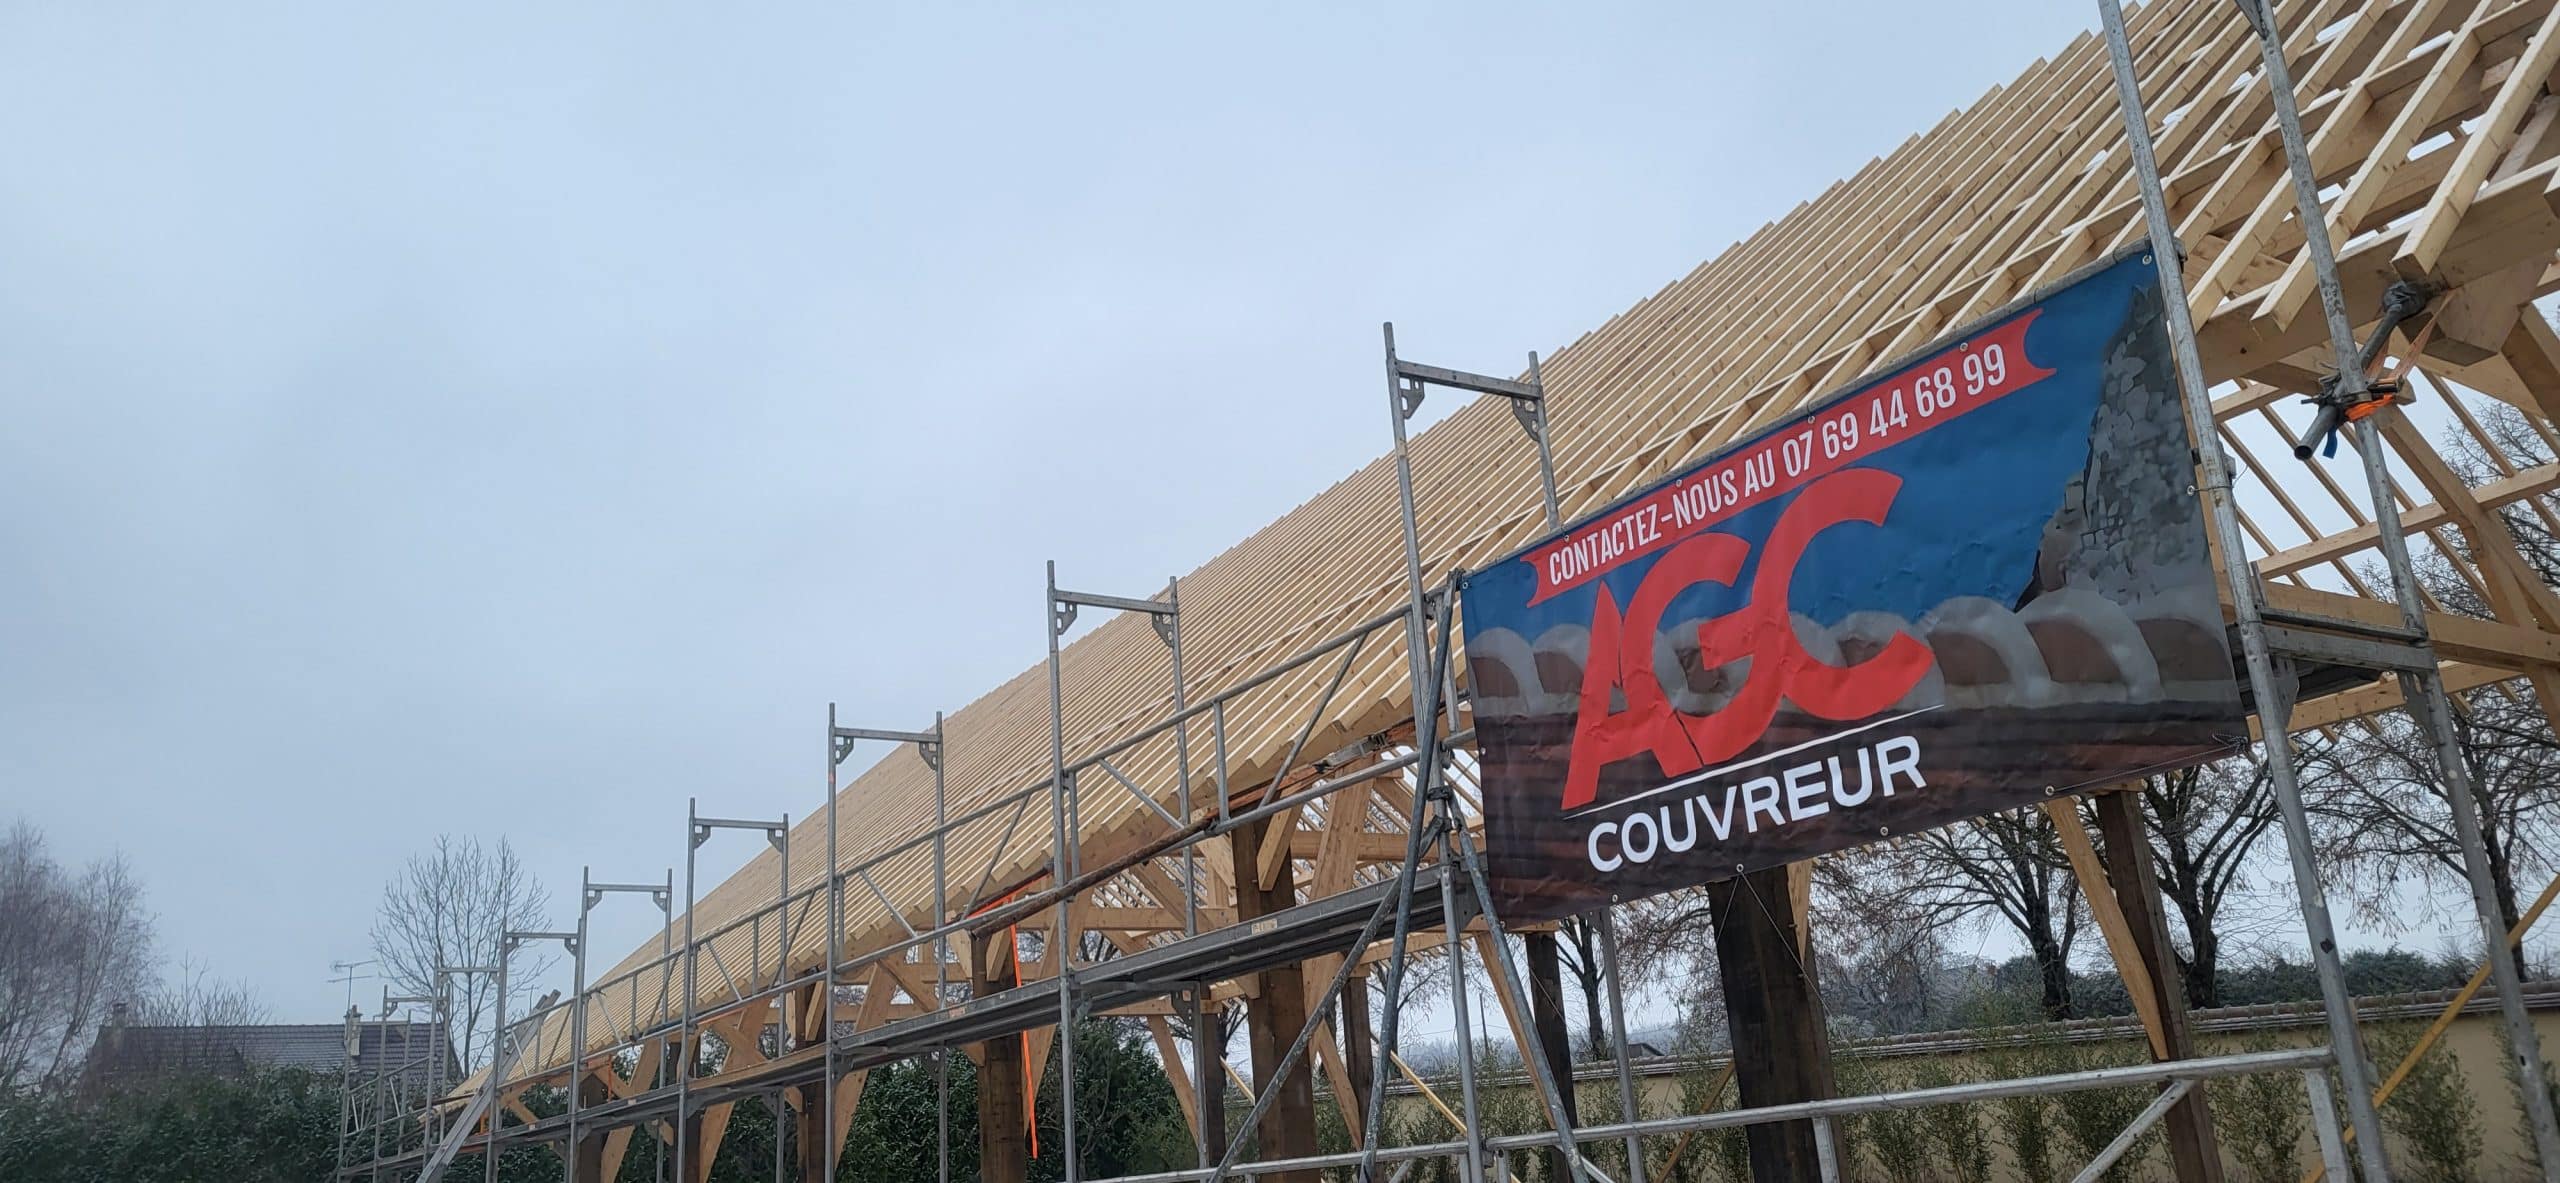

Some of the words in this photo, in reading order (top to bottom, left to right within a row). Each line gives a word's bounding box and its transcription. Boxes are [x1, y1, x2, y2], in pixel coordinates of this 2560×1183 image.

[1549, 469, 1739, 585] CONTACTEZ-NOUS
[1744, 449, 1776, 498] AU
[1782, 430, 1813, 478] 07
[1822, 412, 1859, 459] 69
[1869, 389, 1908, 437] 44
[1915, 367, 1957, 418] 68
[1963, 343, 2006, 395] 99
[1562, 468, 1936, 810] AGC
[1587, 735, 1927, 873] COUVREUR
